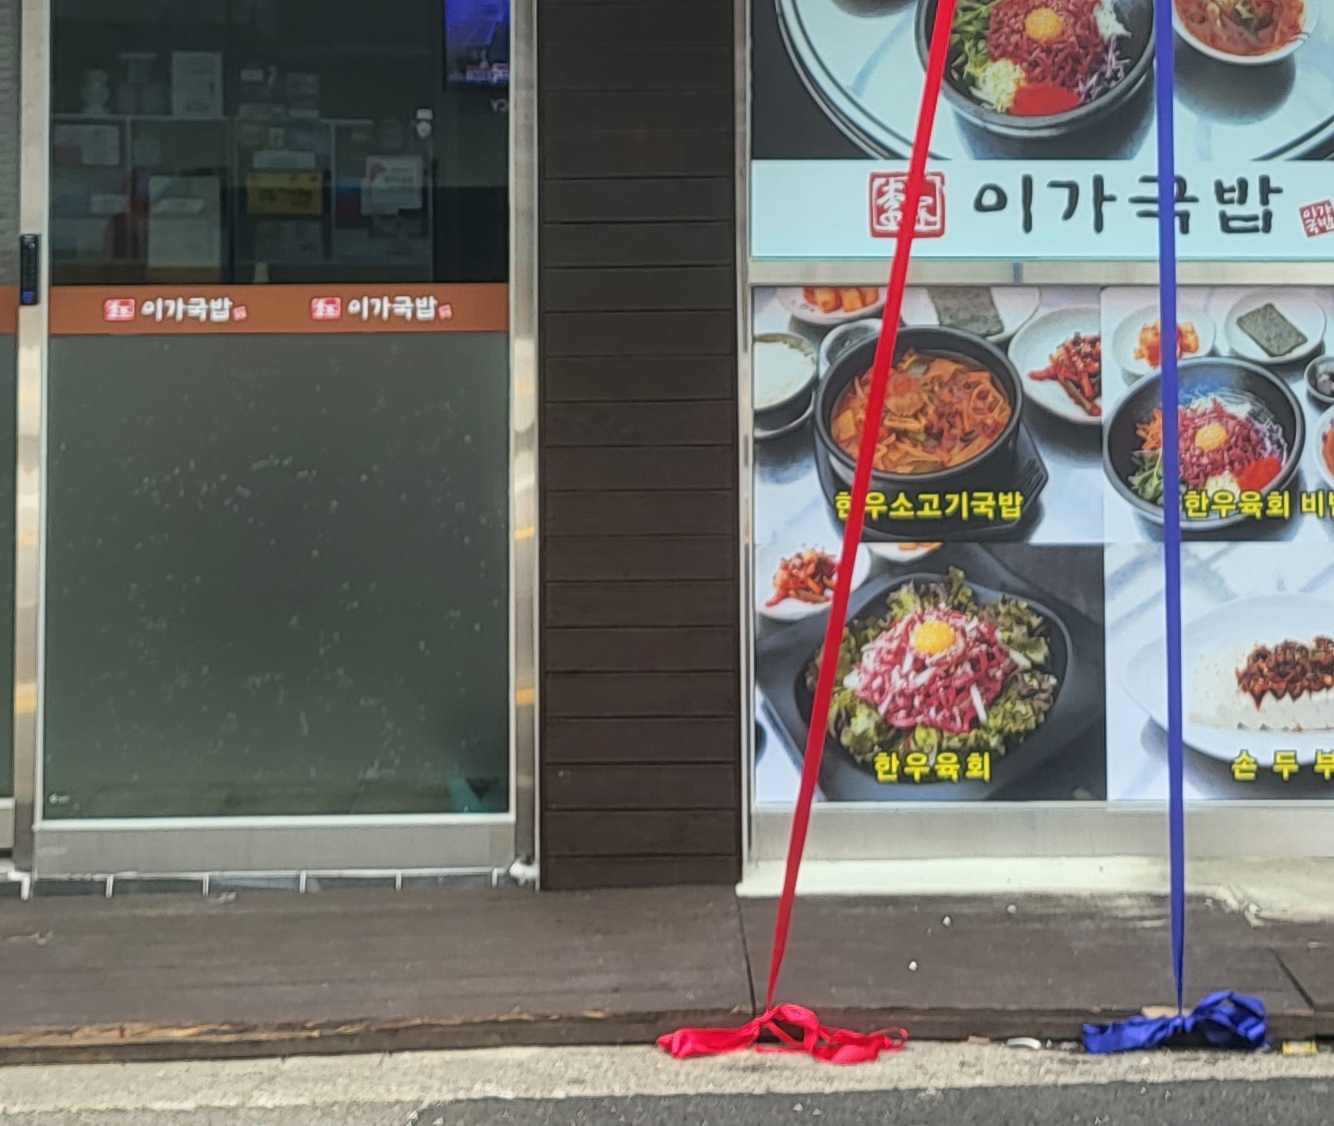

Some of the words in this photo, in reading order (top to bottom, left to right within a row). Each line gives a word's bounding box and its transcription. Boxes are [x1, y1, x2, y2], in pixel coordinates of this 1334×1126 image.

[973, 173, 1284, 235] 이가국밥
[140, 296, 233, 323] 이가국밥
[347, 295, 439, 322] 이가국밥
[834, 490, 1024, 521] 한우소고기국밥
[1183, 490, 1291, 520] 한우육회
[873, 750, 992, 783] 한우육회
